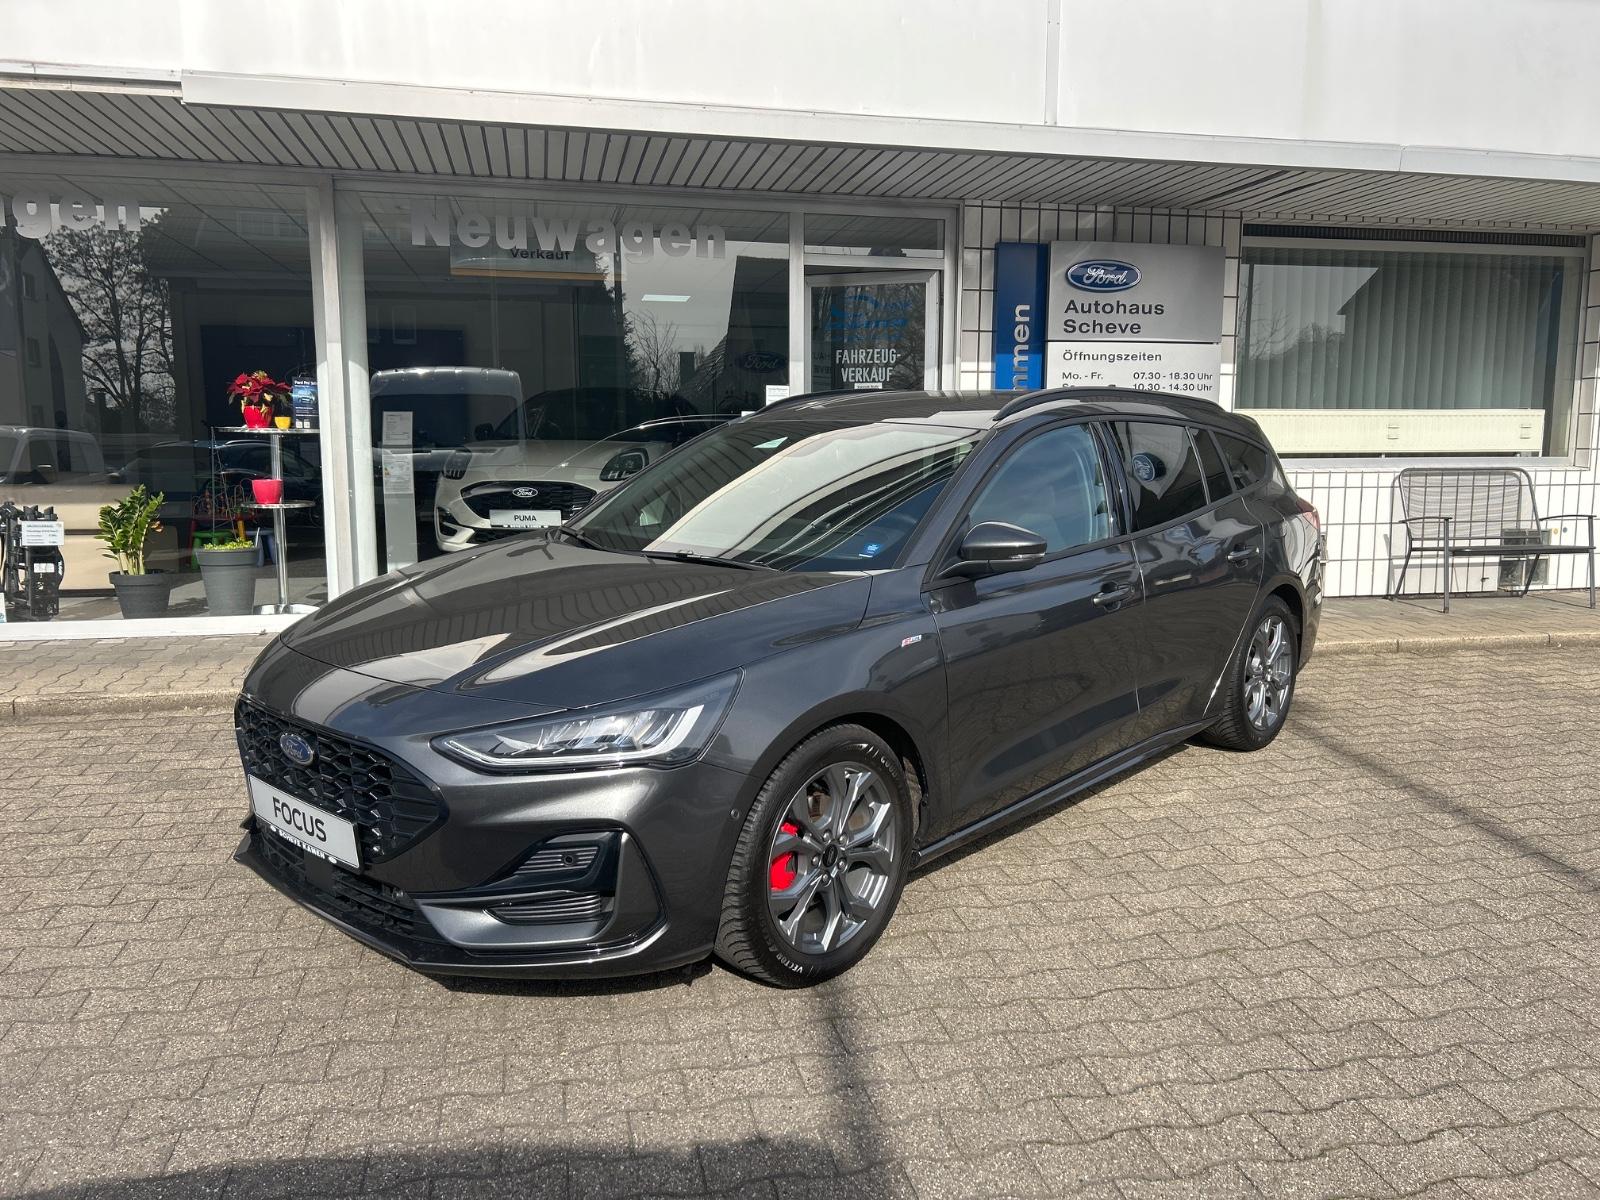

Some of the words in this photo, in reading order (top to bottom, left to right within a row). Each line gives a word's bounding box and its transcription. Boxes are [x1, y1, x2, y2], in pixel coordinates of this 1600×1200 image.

[411, 197, 726, 260] Neuwagen
[511, 247, 570, 261] Verkauf
[1064, 300, 1165, 316] Autohaus
[1063, 319, 1142, 335] Scheve
[836, 348, 901, 364] FAHRZEUG-
[1062, 350, 1163, 364] Öffnungszeiten
[841, 367, 894, 382] VERKAUF
[1062, 372, 1082, 380] Mo.
[1090, 372, 1104, 380] Fr.
[1133, 372, 1161, 380] 07.30
[1197, 384, 1213, 392] Uhr
[272, 796, 327, 842] FOCUS
[776, 952, 803, 973] VECTOR
